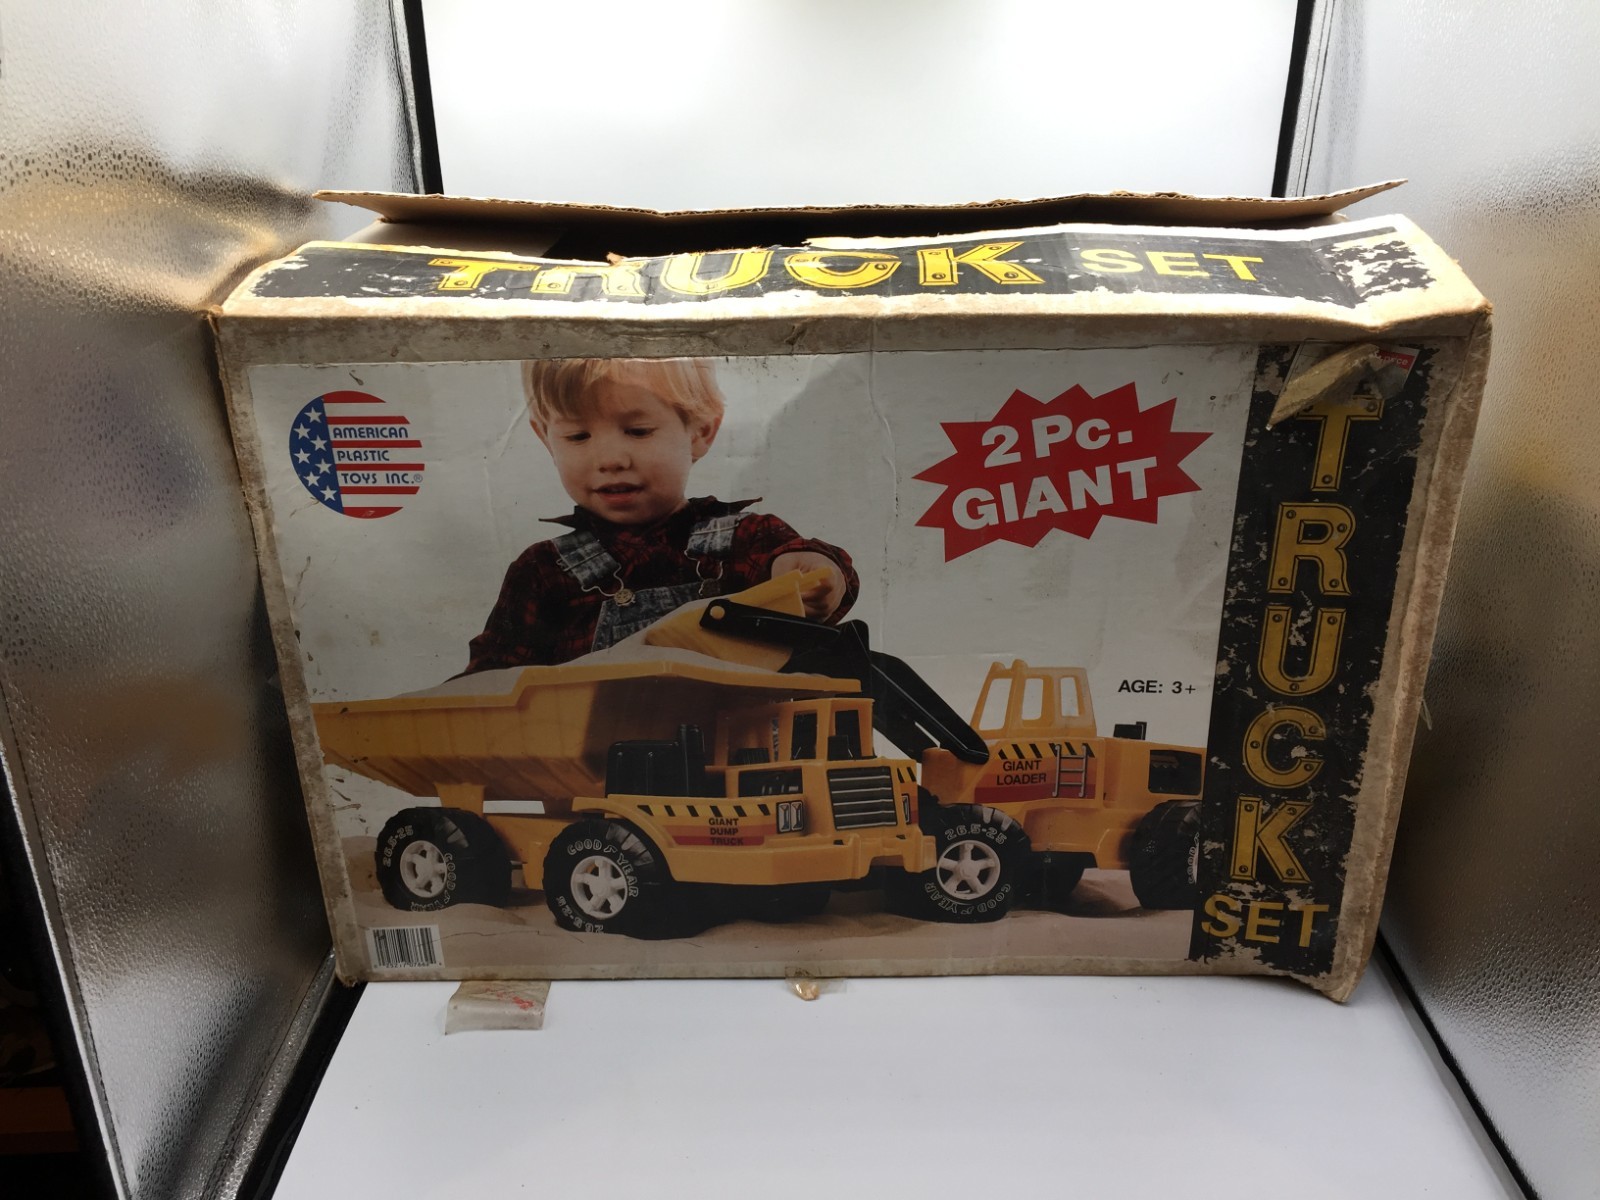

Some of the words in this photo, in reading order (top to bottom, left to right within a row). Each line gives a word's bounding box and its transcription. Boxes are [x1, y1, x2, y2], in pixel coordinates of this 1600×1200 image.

[1081, 247, 1264, 283] SET
[332, 426, 409, 439] AMERICAN
[982, 425, 1021, 469] 2
[1033, 413, 1133, 460] Pc.
[336, 450, 390, 461] PLASTIC
[341, 472, 378, 484] TOYS
[950, 455, 1158, 532] GIANT
[1230, 394, 1384, 884] TRUCK
[1117, 679, 1163, 694] AGE:
[1171, 681, 1196, 694] 3+
[1002, 759, 1042, 772] GIANT
[996, 772, 1047, 786] LOADER
[708, 817, 739, 826] GIANT
[710, 827, 739, 836] DUMP
[944, 823, 1008, 845] 26.5-25
[710, 837, 744, 846] TRUCK
[1201, 892, 1330, 949] SET
